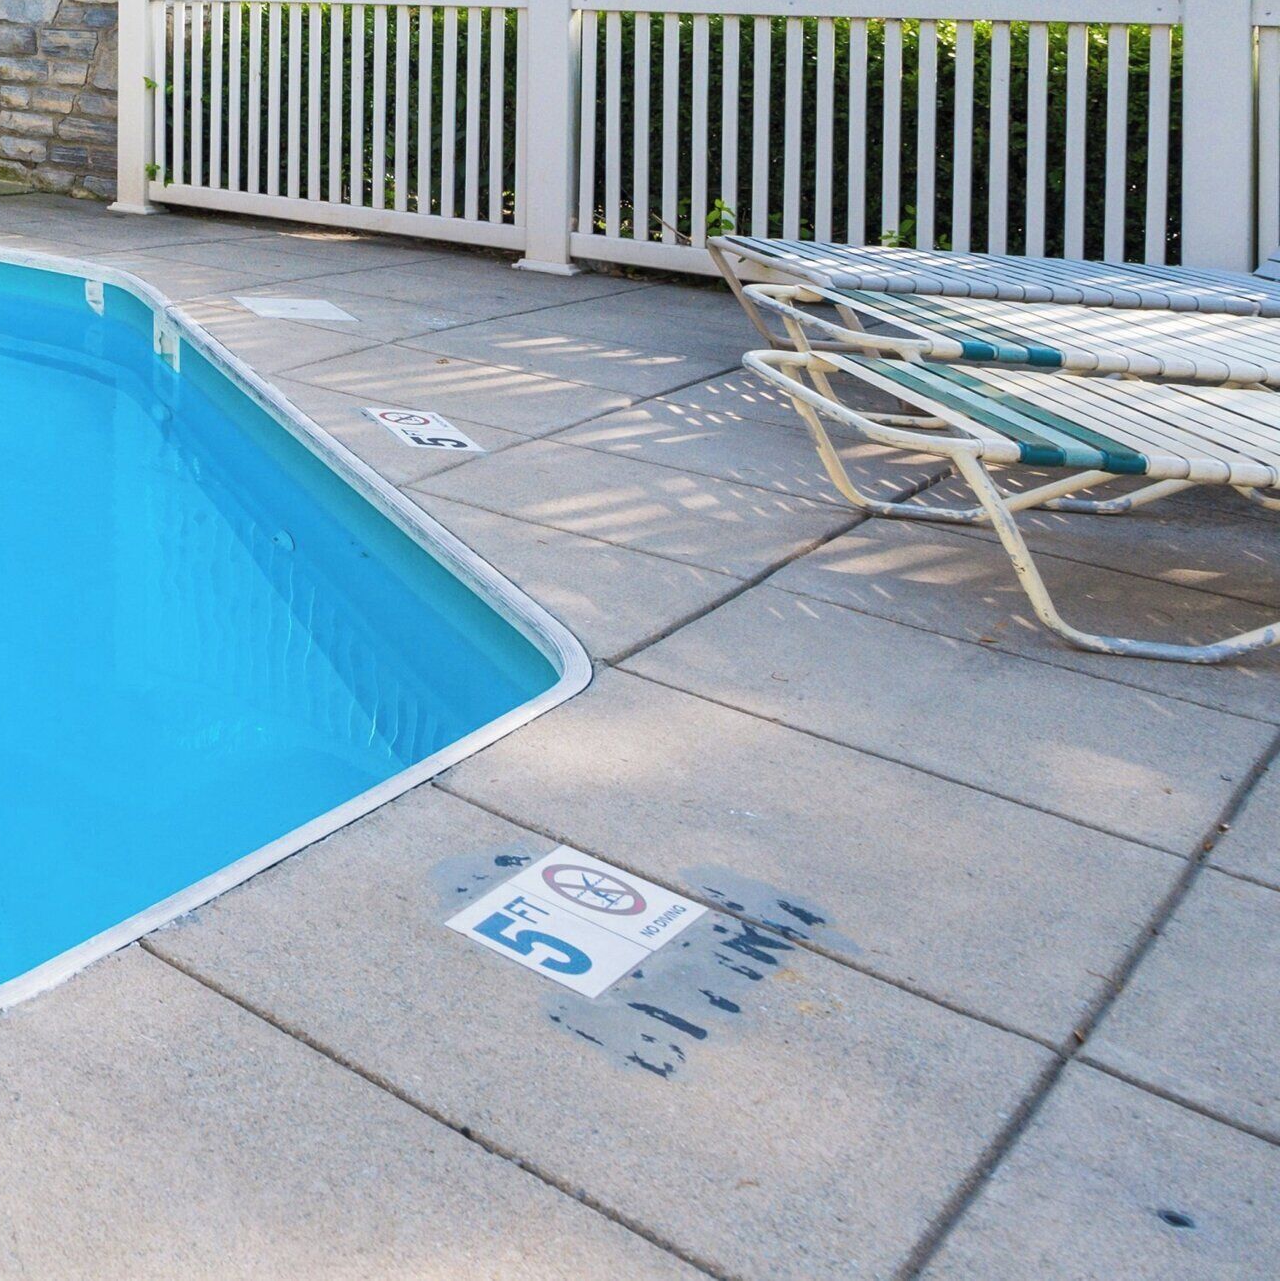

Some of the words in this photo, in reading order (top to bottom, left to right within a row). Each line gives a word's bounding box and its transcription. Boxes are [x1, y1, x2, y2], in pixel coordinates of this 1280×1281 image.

[410, 436, 469, 448] 5
[502, 895, 551, 925] FT
[639, 922, 660, 939] NO
[652, 903, 688, 933] DIVING
[472, 911, 594, 976] 5
